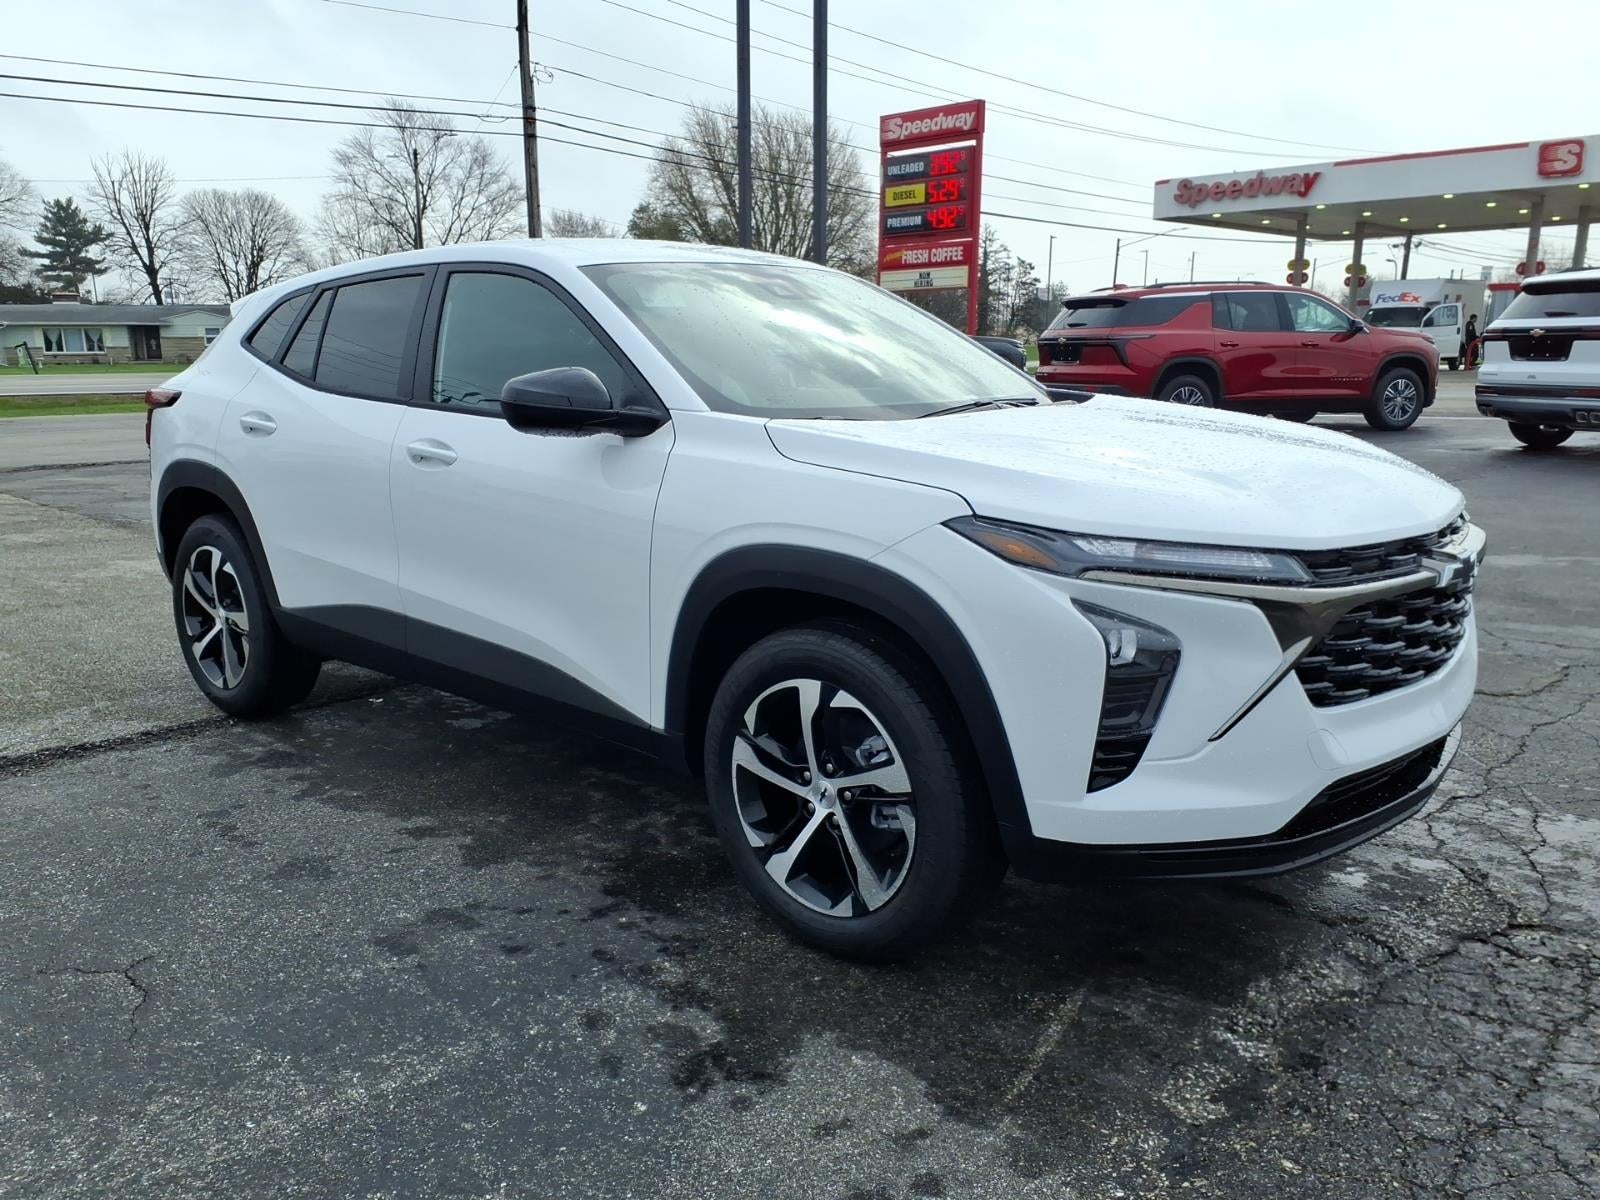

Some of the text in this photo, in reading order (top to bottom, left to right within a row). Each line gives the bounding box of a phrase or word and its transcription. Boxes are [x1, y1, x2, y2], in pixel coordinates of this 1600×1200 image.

[885, 111, 976, 139] Speedway
[887, 162, 924, 176] UNLEADED
[892, 190, 917, 201] DIESEL
[1173, 169, 1321, 208] Speedway
[887, 215, 922, 229] PREMIUM
[902, 246, 964, 265] FRESH COFFEE
[919, 271, 931, 280] NOW
[913, 279, 934, 288] HIRING
[1375, 291, 1422, 304] FedEx
